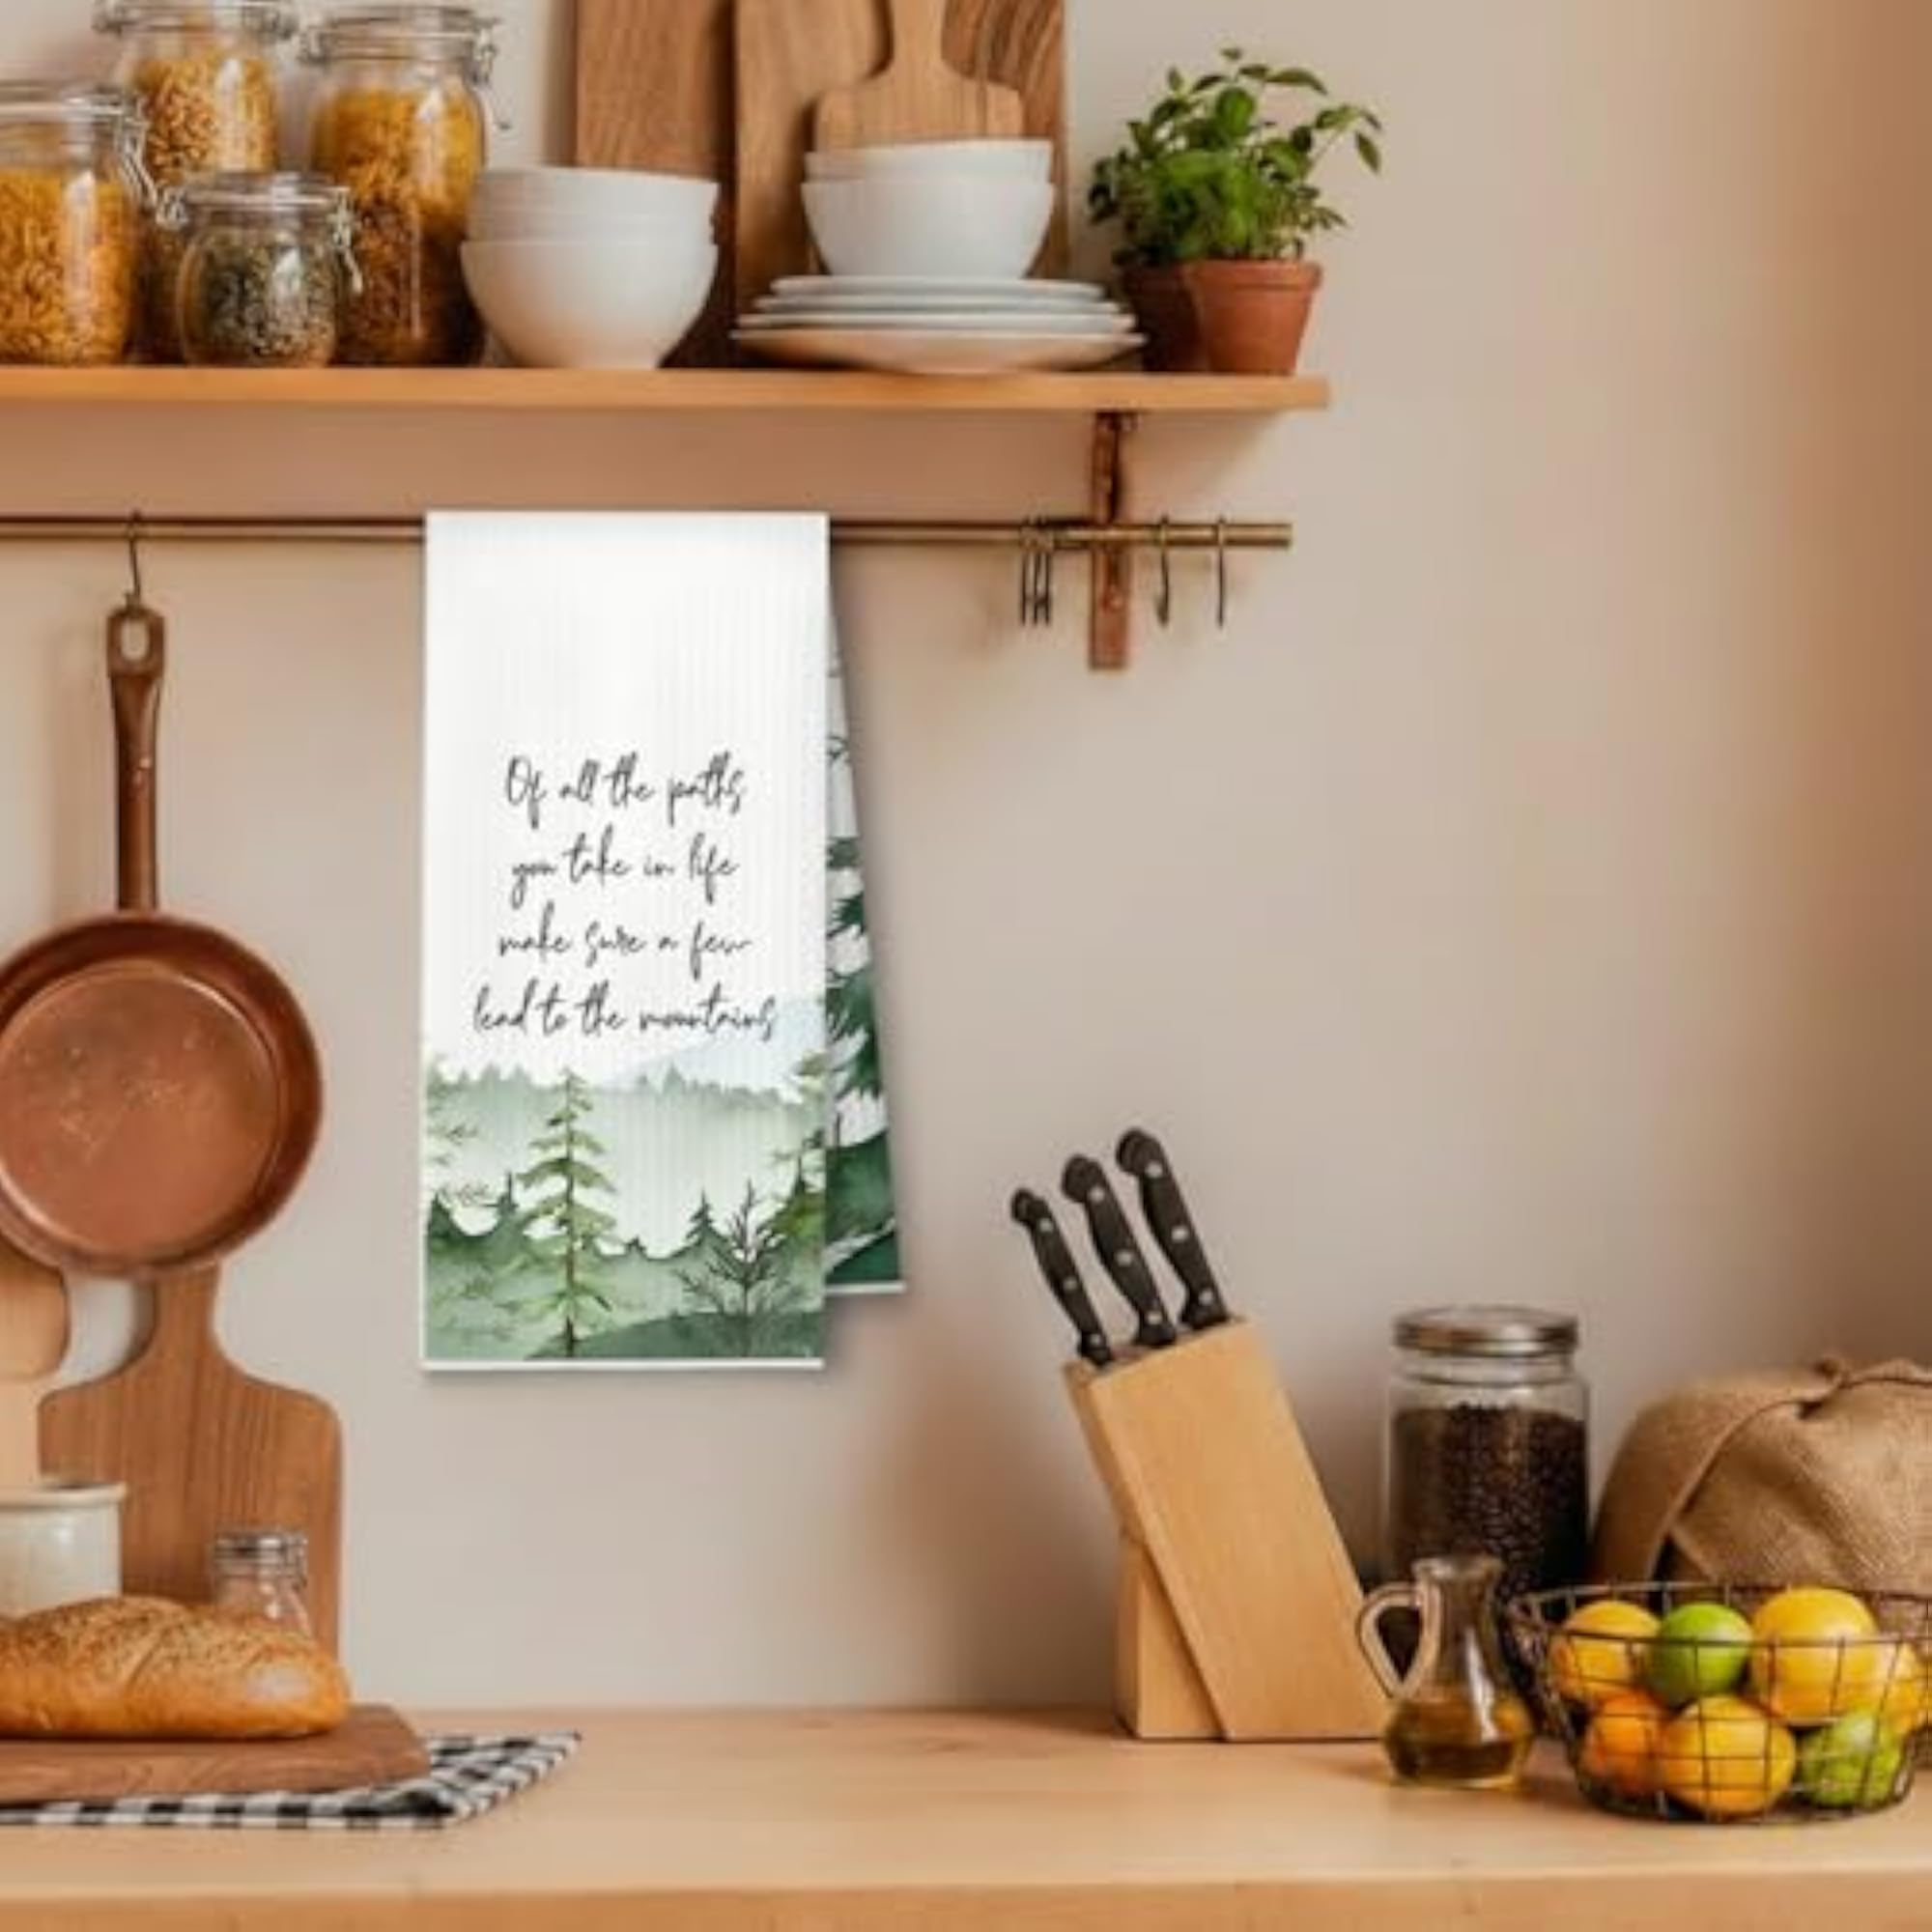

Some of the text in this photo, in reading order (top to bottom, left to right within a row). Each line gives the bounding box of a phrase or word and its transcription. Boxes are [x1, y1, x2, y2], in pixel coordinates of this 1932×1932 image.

[505, 750, 747, 830] Of all the paths
[512, 823, 740, 910] you take in life
[498, 899, 753, 982] make sure a few
[473, 978, 776, 1043] lead to the mountains
